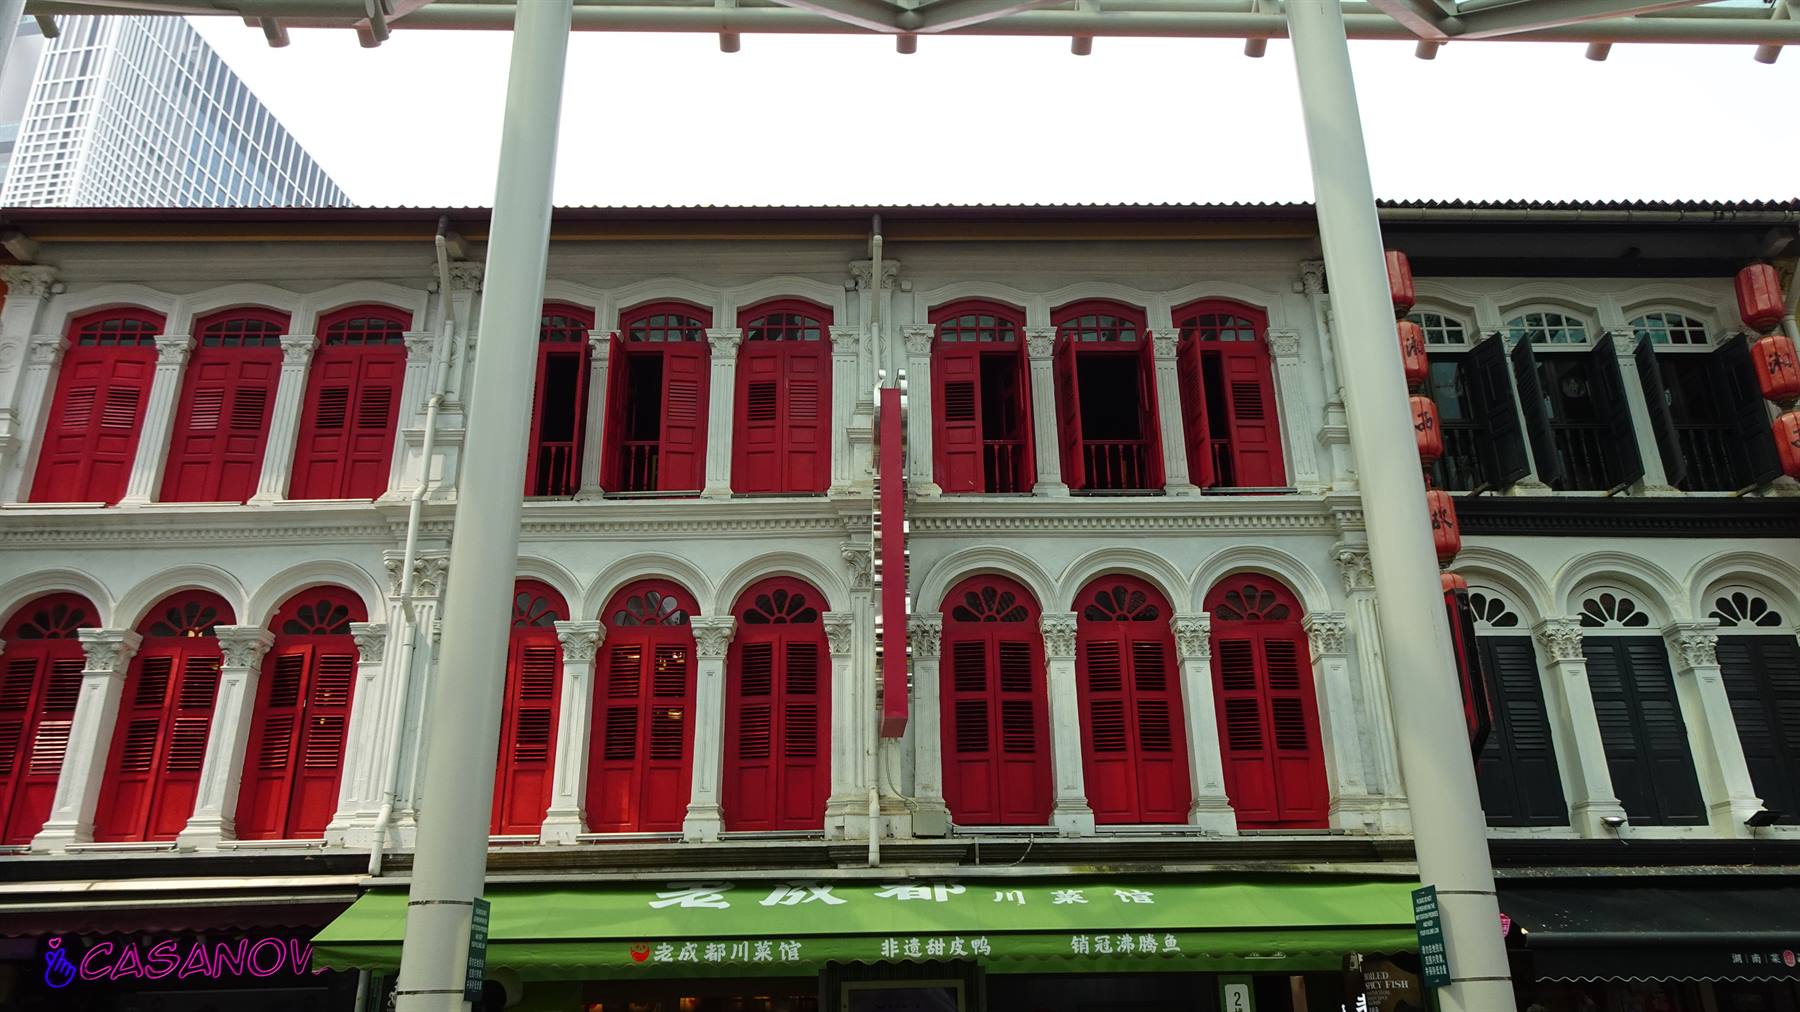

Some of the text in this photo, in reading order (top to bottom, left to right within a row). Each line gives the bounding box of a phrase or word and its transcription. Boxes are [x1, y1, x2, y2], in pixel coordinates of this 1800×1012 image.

[654, 940, 801, 962] 老成都川菜馆
[881, 935, 991, 958] 非遗甜皮鸭
[1070, 933, 1181, 955] 销冠沸腾鱼
[80, 937, 326, 981] CASANOV
[1385, 980, 1409, 989] FISH
[1233, 991, 1242, 1007] 2
